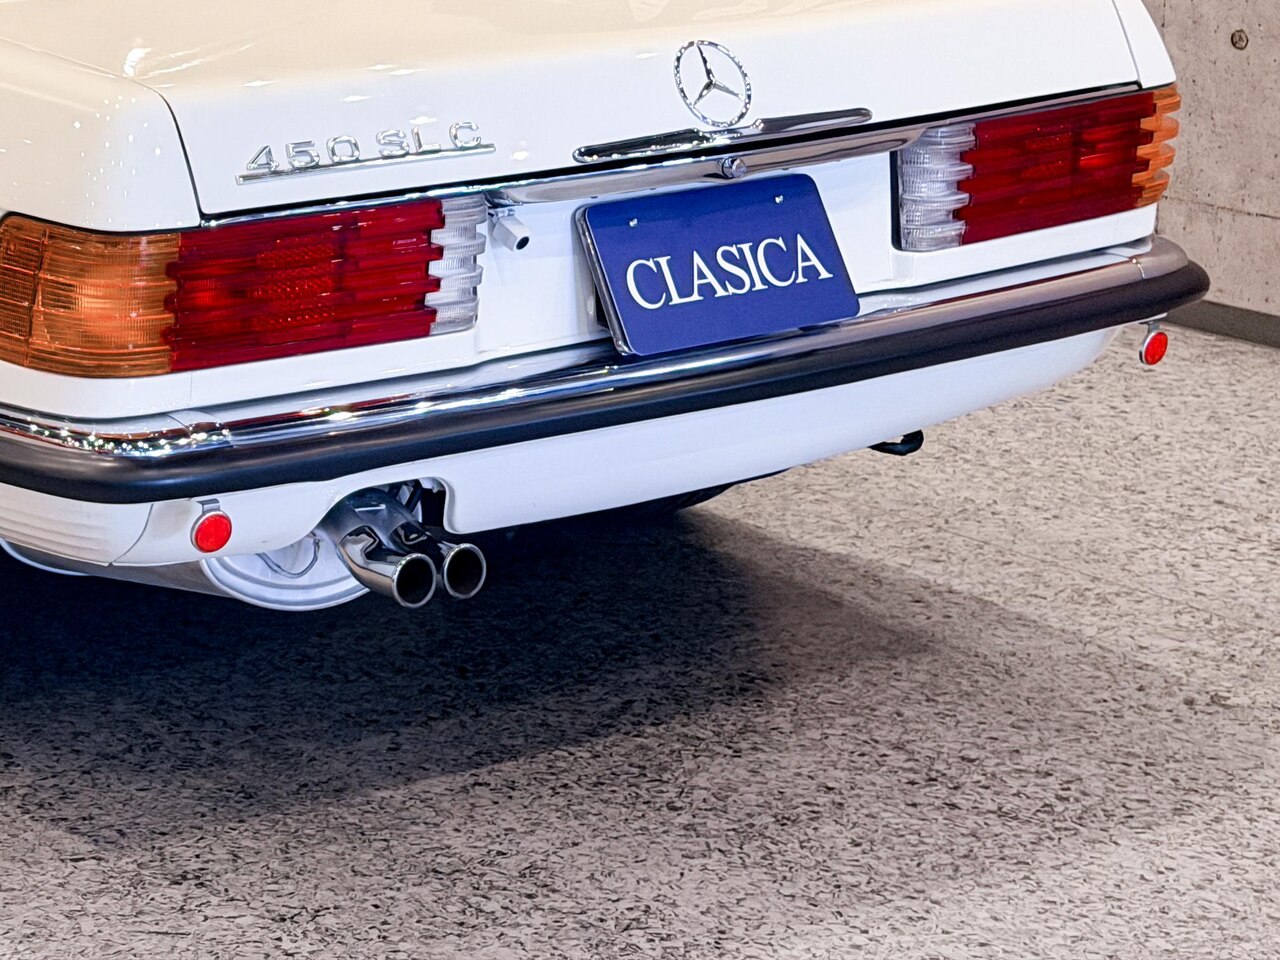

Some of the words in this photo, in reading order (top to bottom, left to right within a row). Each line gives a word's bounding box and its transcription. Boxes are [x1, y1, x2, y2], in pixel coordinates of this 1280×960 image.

[246, 135, 361, 172] 450
[376, 121, 482, 158] SLC
[626, 233, 834, 310] CLASICA
